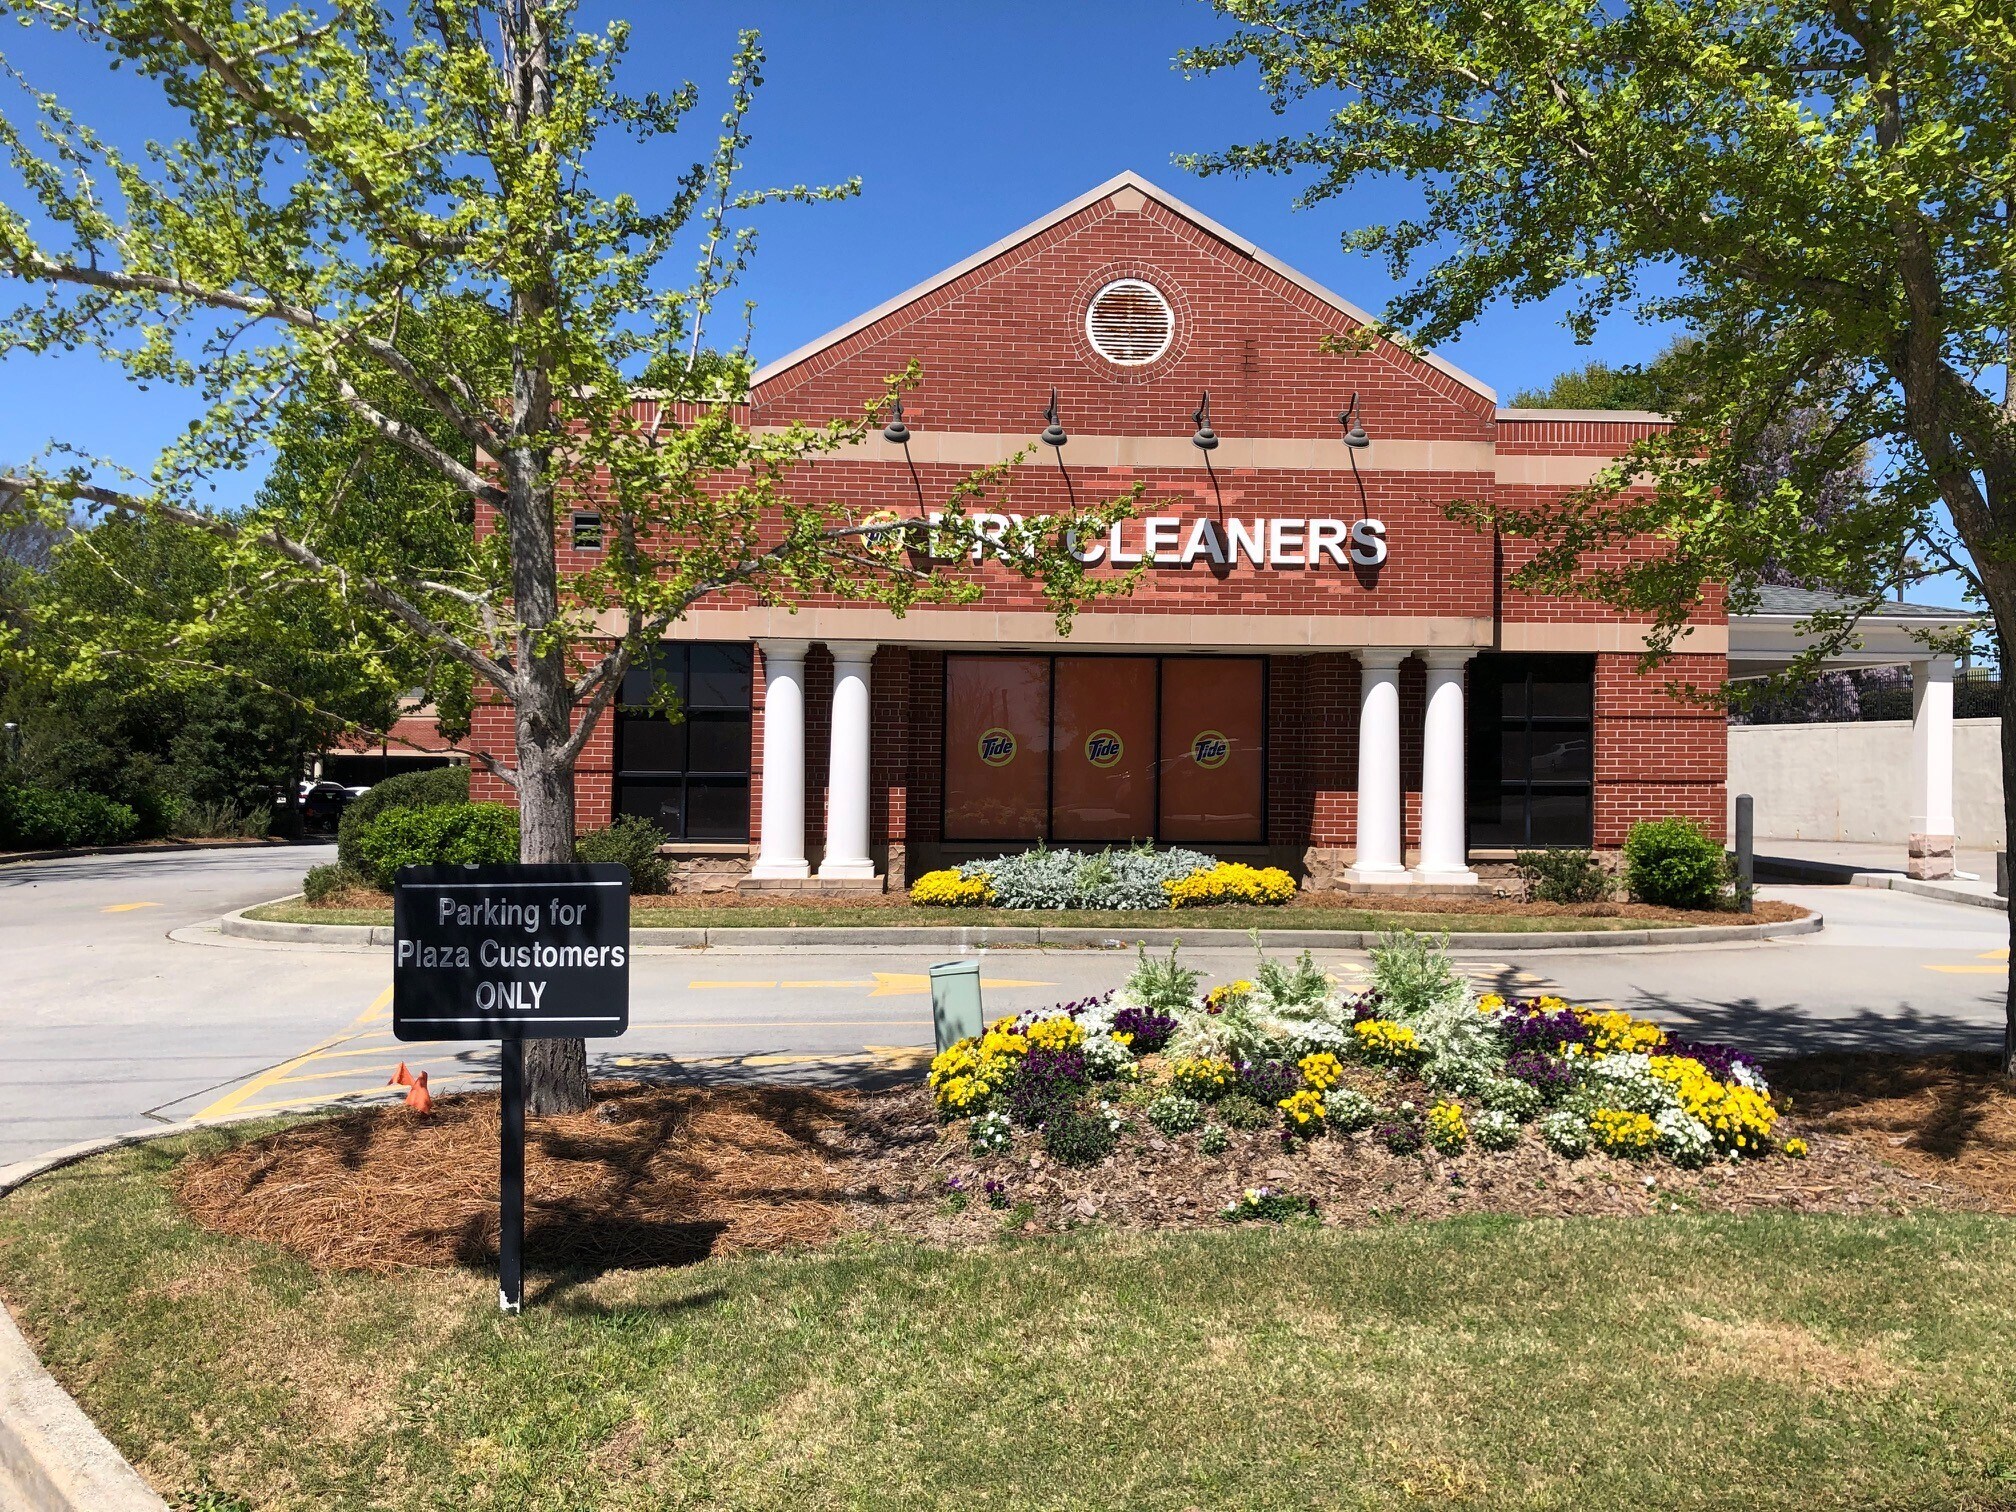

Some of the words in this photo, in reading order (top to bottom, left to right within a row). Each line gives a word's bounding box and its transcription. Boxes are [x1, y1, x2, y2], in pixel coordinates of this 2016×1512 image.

[1067, 517, 1387, 565] CLEANERS
[982, 738, 1013, 760] Tide
[1089, 740, 1120, 761] Tide
[1195, 741, 1226, 762] Tide
[438, 897, 540, 933] Parking
[550, 898, 587, 926] for
[397, 939, 470, 968] Plaza
[480, 939, 625, 968] Customers
[475, 981, 547, 1010] ONLY
